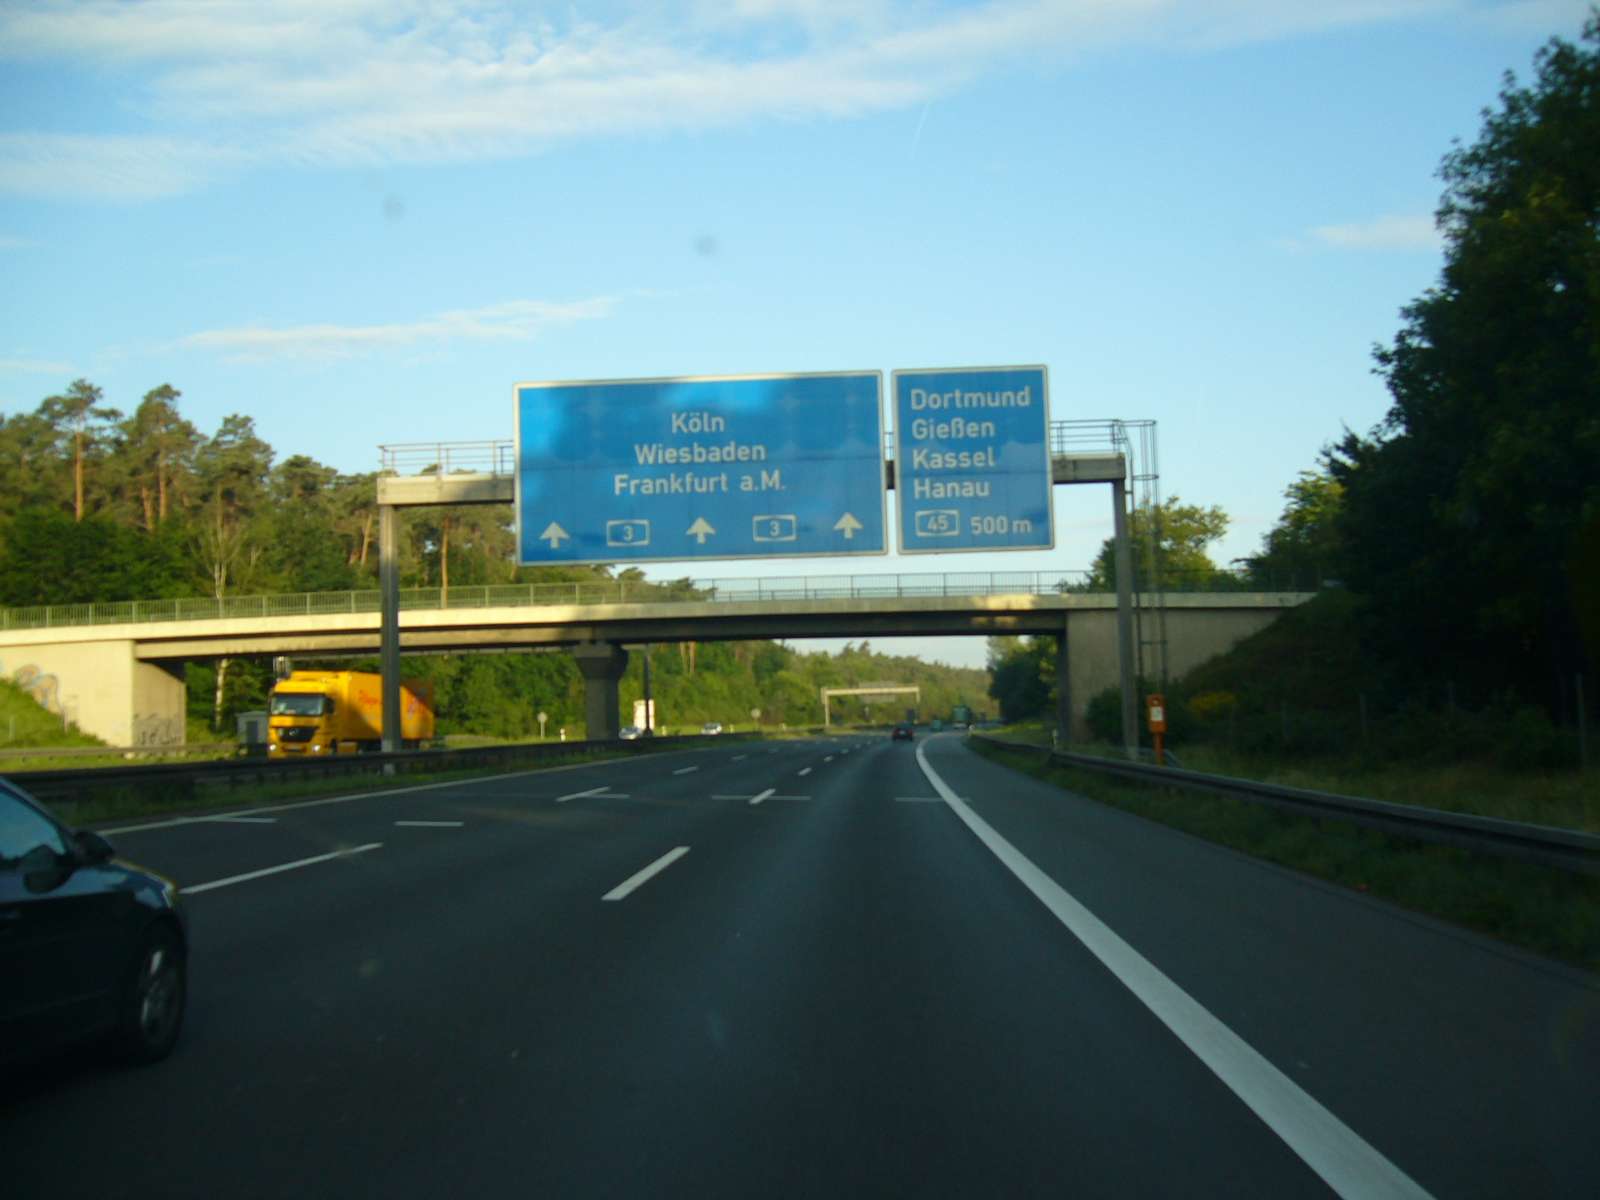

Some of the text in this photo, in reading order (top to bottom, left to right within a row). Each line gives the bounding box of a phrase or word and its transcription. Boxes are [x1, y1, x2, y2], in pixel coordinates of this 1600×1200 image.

[910, 386, 1031, 410] Dortmund
[671, 411, 725, 434] Köln
[912, 417, 994, 439] Gießen
[635, 442, 766, 465] Wiesbaden
[913, 447, 995, 469] Kassel
[614, 473, 729, 496] Frankfurt
[914, 478, 990, 499] Hanau
[623, 525, 634, 542] 3
[769, 520, 780, 537] 3
[927, 515, 949, 531] 45
[970, 516, 1008, 534] 500
